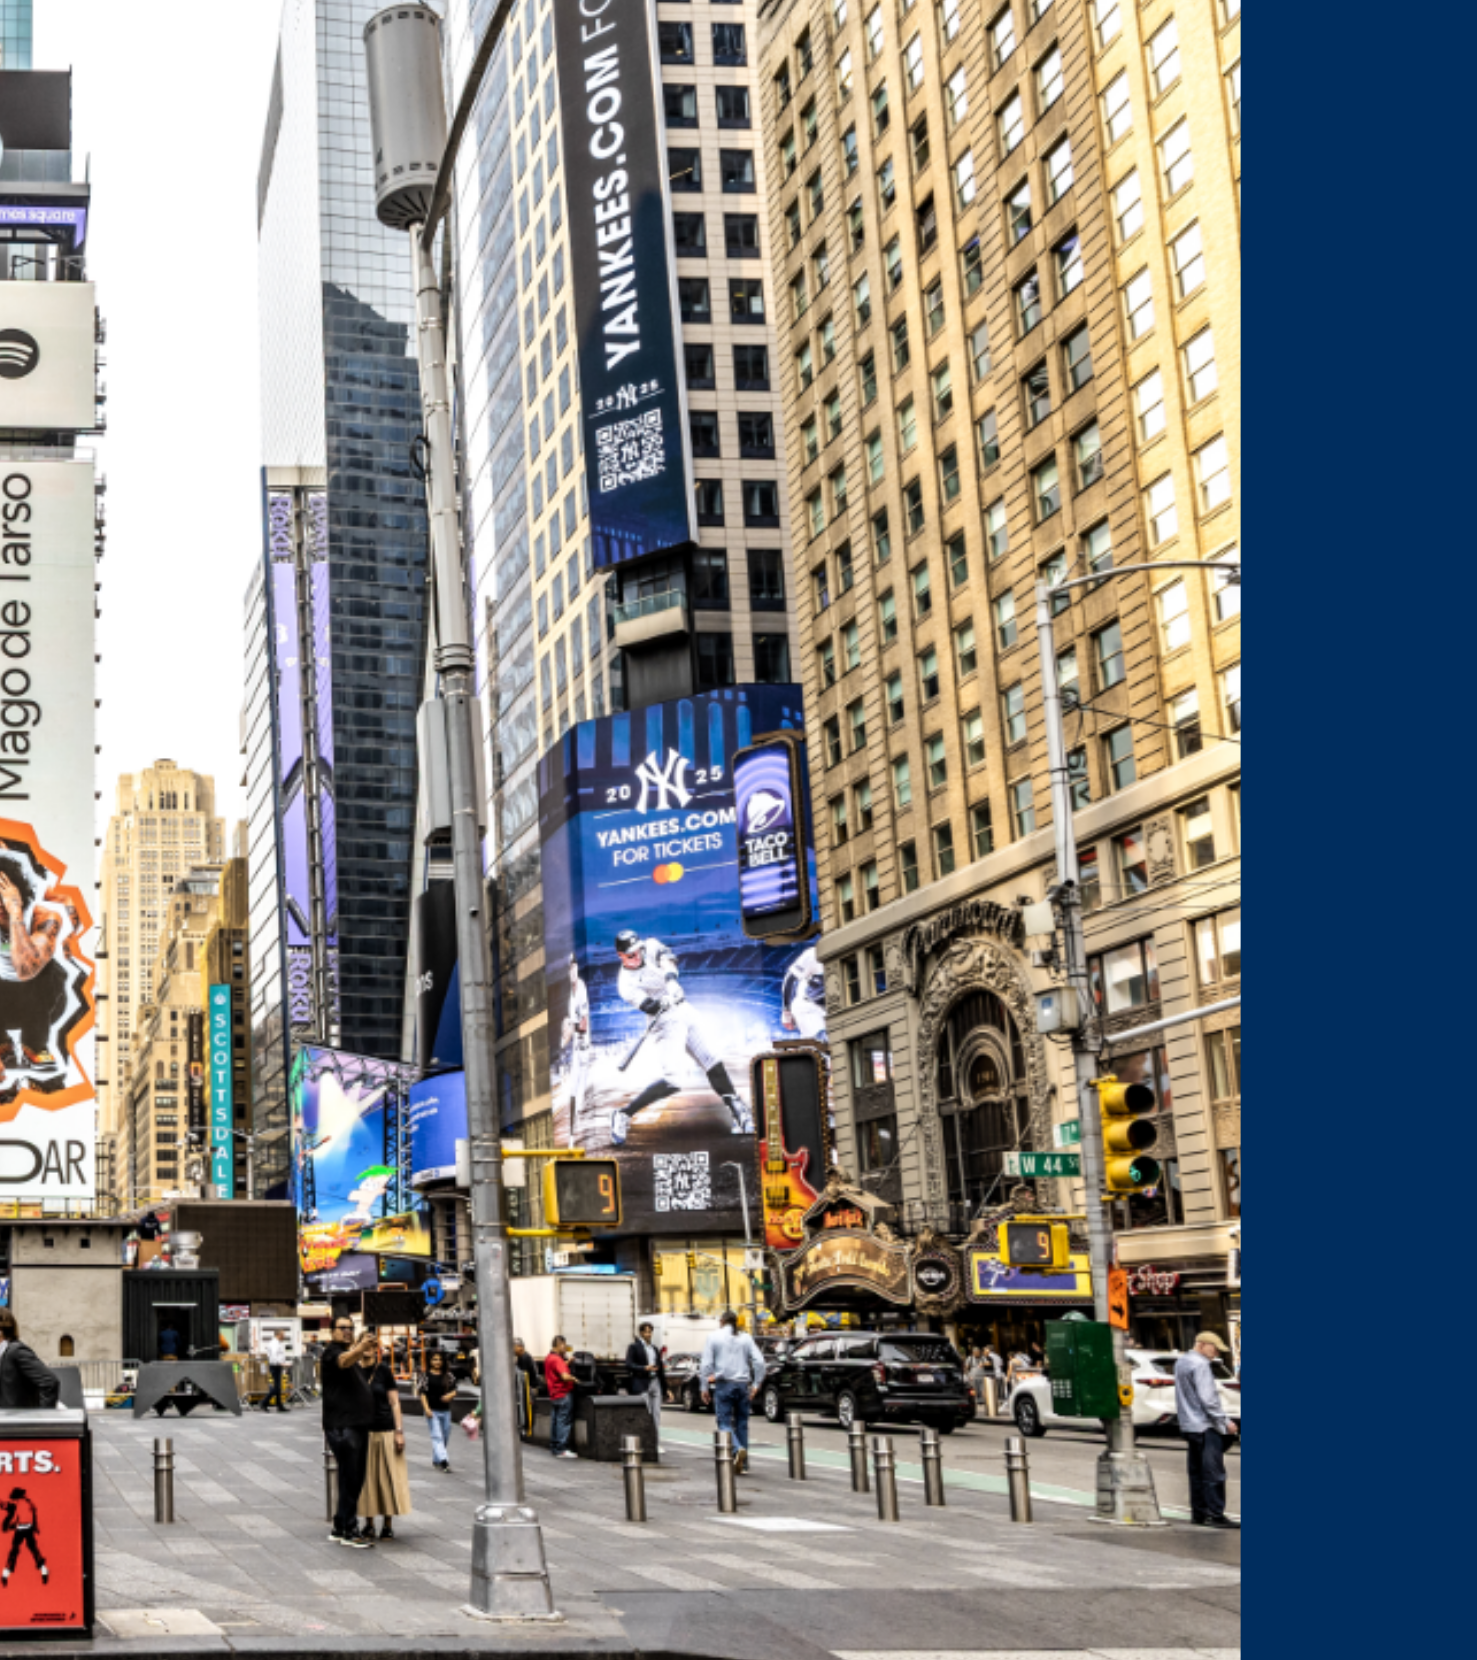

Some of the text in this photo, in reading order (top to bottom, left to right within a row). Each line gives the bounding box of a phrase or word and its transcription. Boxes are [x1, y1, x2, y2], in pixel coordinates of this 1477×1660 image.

[583, 44, 641, 371] YANKEES.COM
[606, 784, 631, 803] 20
[695, 765, 723, 784] 25
[596, 806, 737, 849] YANKEES.COM
[745, 832, 789, 854] TACO
[613, 832, 723, 867] FOR TICKETS
[748, 848, 789, 868] BELL
[214, 1012, 228, 1199] SCOTTSDALE
[1023, 1156, 1036, 1174] W
[1043, 1156, 1062, 1174] 44
